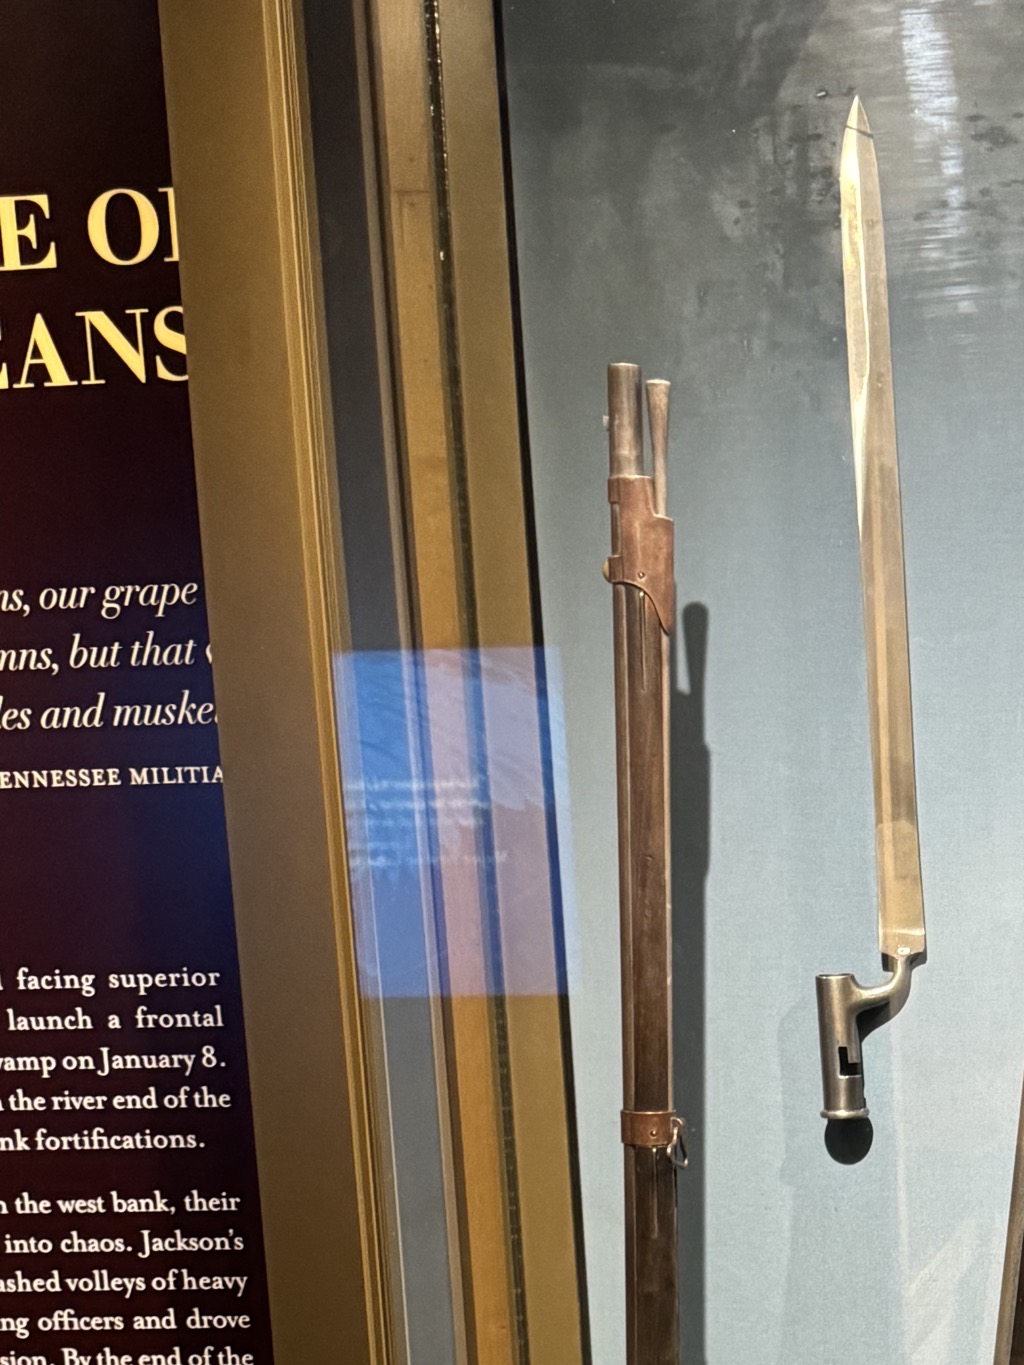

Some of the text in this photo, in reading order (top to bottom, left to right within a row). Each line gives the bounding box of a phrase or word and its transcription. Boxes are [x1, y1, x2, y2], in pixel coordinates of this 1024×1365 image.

[0, 306, 188, 389] ANS
[39, 585, 96, 610] our
[100, 582, 198, 620] grape
[69, 633, 123, 669] but
[130, 630, 197, 667] that
[40, 692, 106, 728] and
[112, 689, 218, 726] muske
[16, 967, 96, 997] facing
[108, 967, 220, 995] superior
[6, 1004, 224, 1031] launch a frontal
[62, 1055, 96, 1070] on
[97, 1047, 196, 1076] January
[201, 1045, 226, 1068] 8.
[9, 1088, 46, 1111] the
[51, 1090, 107, 1110] river
[112, 1086, 158, 1110] end
[163, 1086, 191, 1108] of
[193, 1086, 232, 1108] the
[35, 1127, 206, 1151] fortifications.
[14, 1192, 52, 1214] the
[57, 1195, 107, 1214] west
[110, 1190, 176, 1215] bank,
[184, 1189, 241, 1212] their
[4, 1234, 53, 1254] into
[60, 1231, 133, 1253] chaos.
[65, 1269, 146, 1299] volleys
[151, 1268, 179, 1290] of
[182, 1268, 248, 1297] heavy
[37, 1308, 125, 1331] officers
[133, 1307, 177, 1330] and
[186, 1307, 251, 1329] drove
